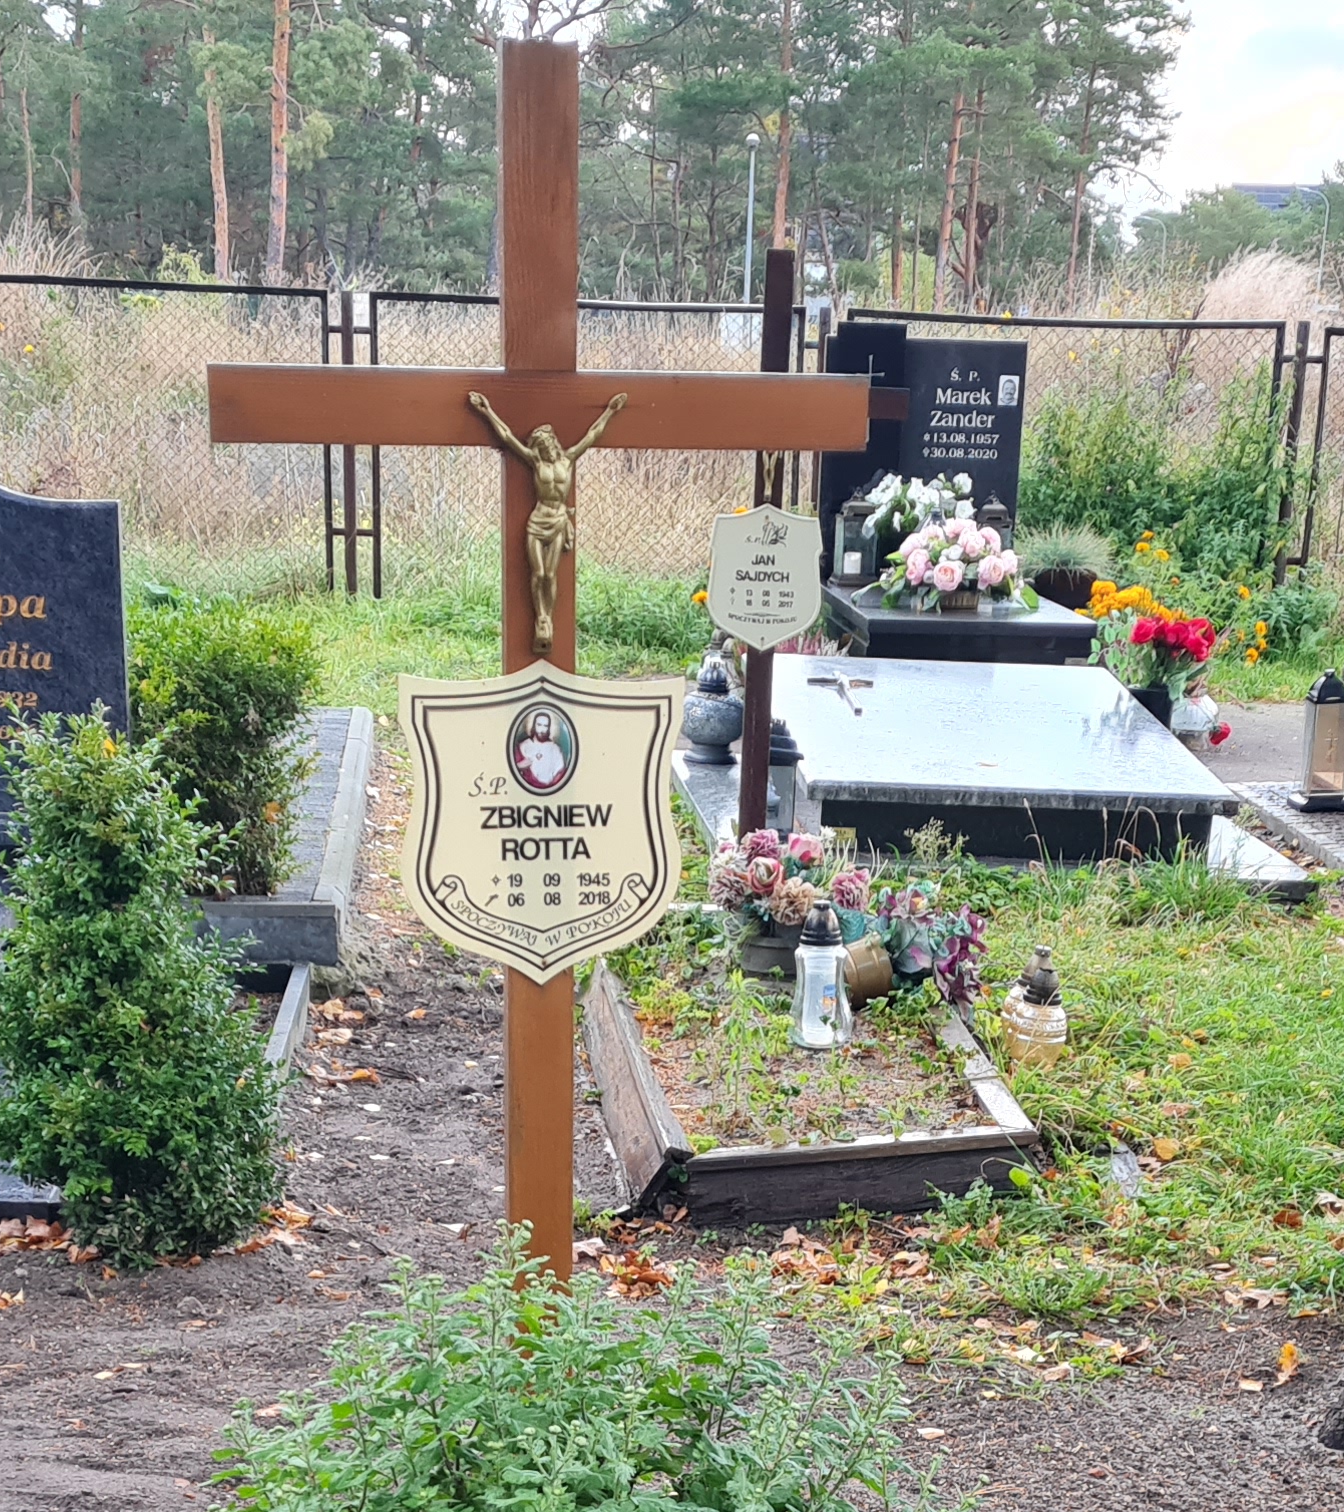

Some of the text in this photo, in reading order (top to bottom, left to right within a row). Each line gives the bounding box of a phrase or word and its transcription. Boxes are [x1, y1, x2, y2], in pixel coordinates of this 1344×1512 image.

[936, 387, 992, 405] Marek
[929, 410, 995, 428] Zander
[751, 554, 775, 566] JAN
[735, 569, 790, 583] SAJDYCH
[468, 772, 508, 798] Ś.P.
[479, 803, 613, 830] ZBIGNIEW
[501, 836, 591, 862] ROTTA
[507, 872, 611, 888] 19 09 1945
[507, 890, 611, 908] 06 08 2018
[450, 899, 633, 947] SPOCZYWAJ W POKOJU
